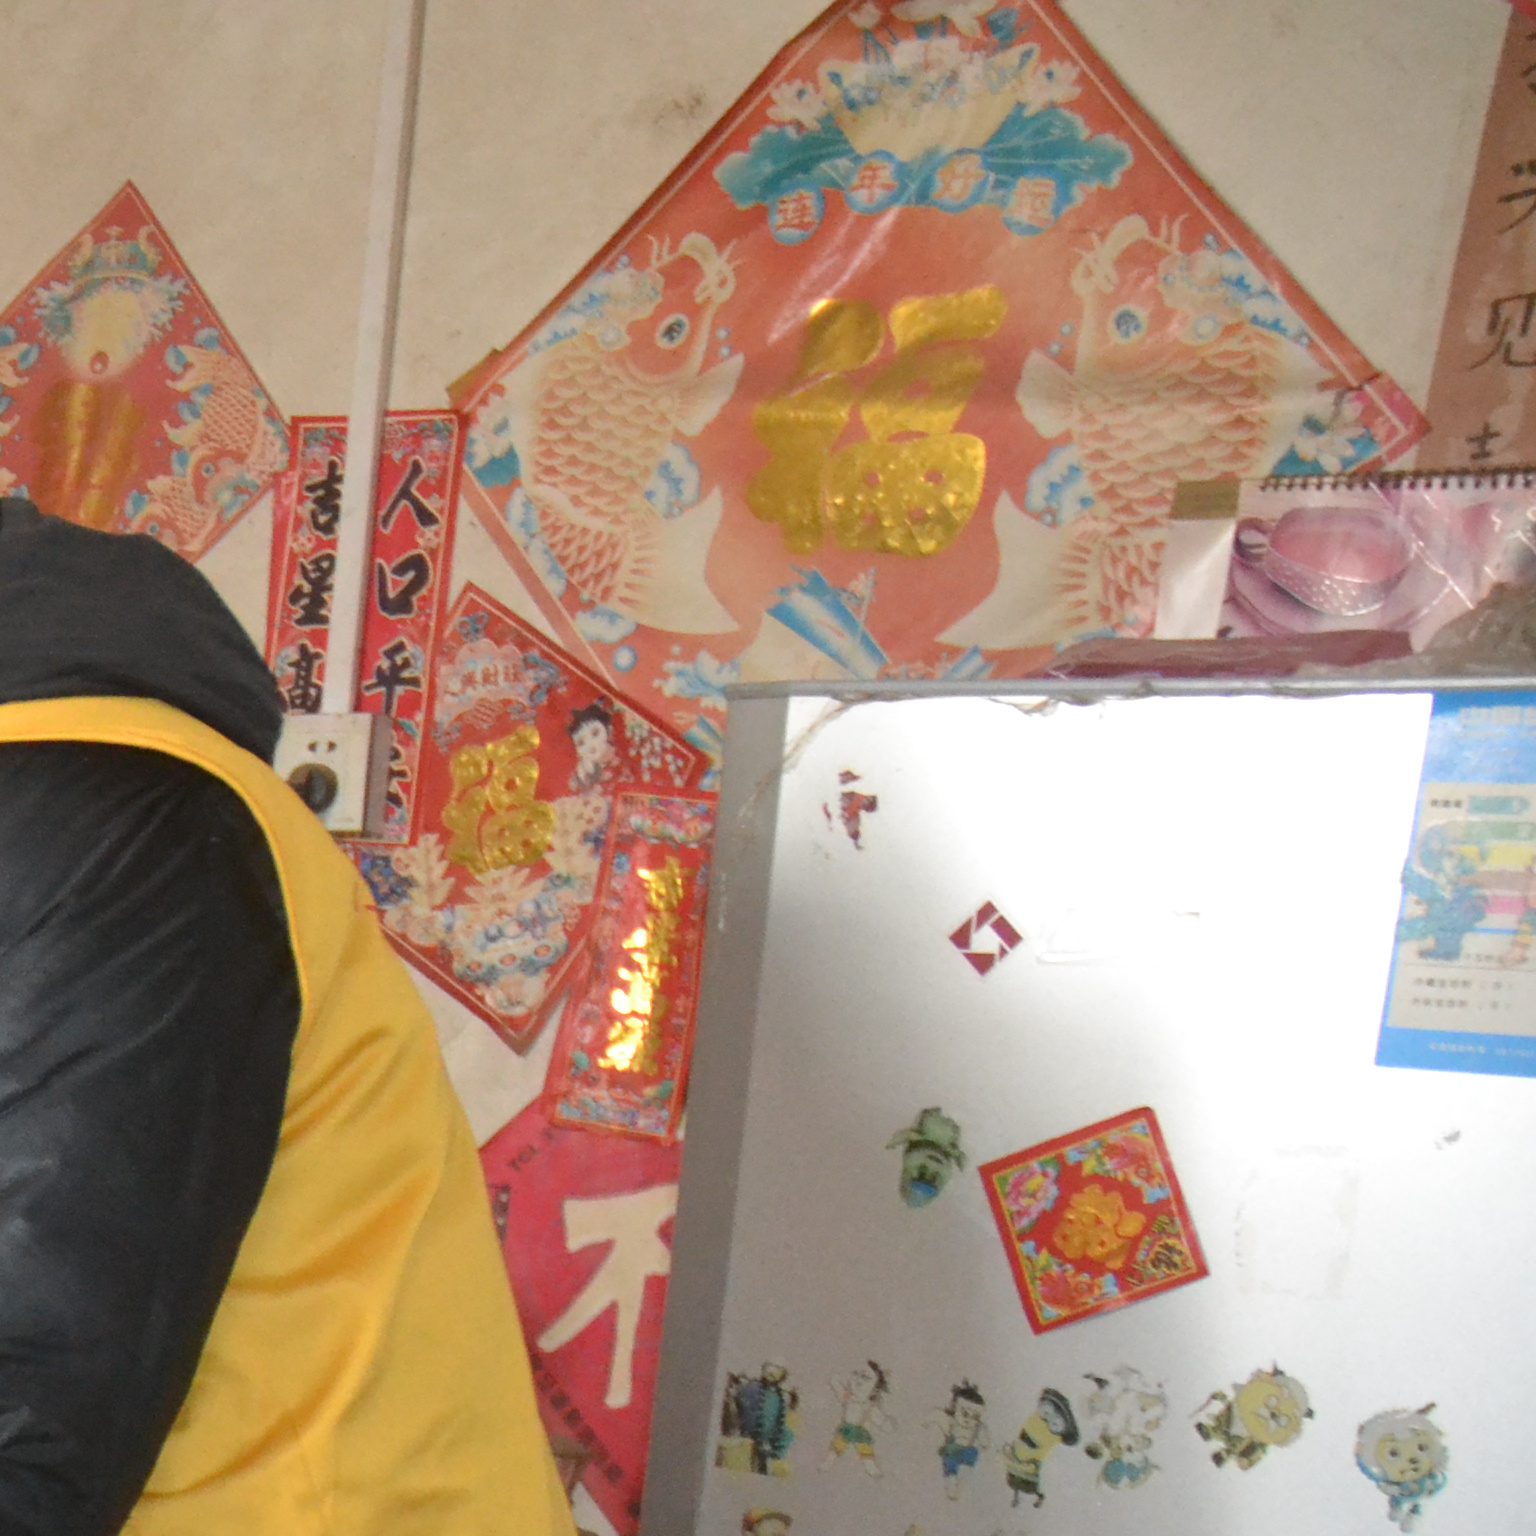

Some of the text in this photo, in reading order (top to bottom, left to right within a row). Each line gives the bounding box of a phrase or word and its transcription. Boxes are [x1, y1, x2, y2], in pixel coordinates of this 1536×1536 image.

[747, 284, 1008, 559] 福
[284, 458, 344, 714] 吉星高
[442, 724, 556, 876] 福
